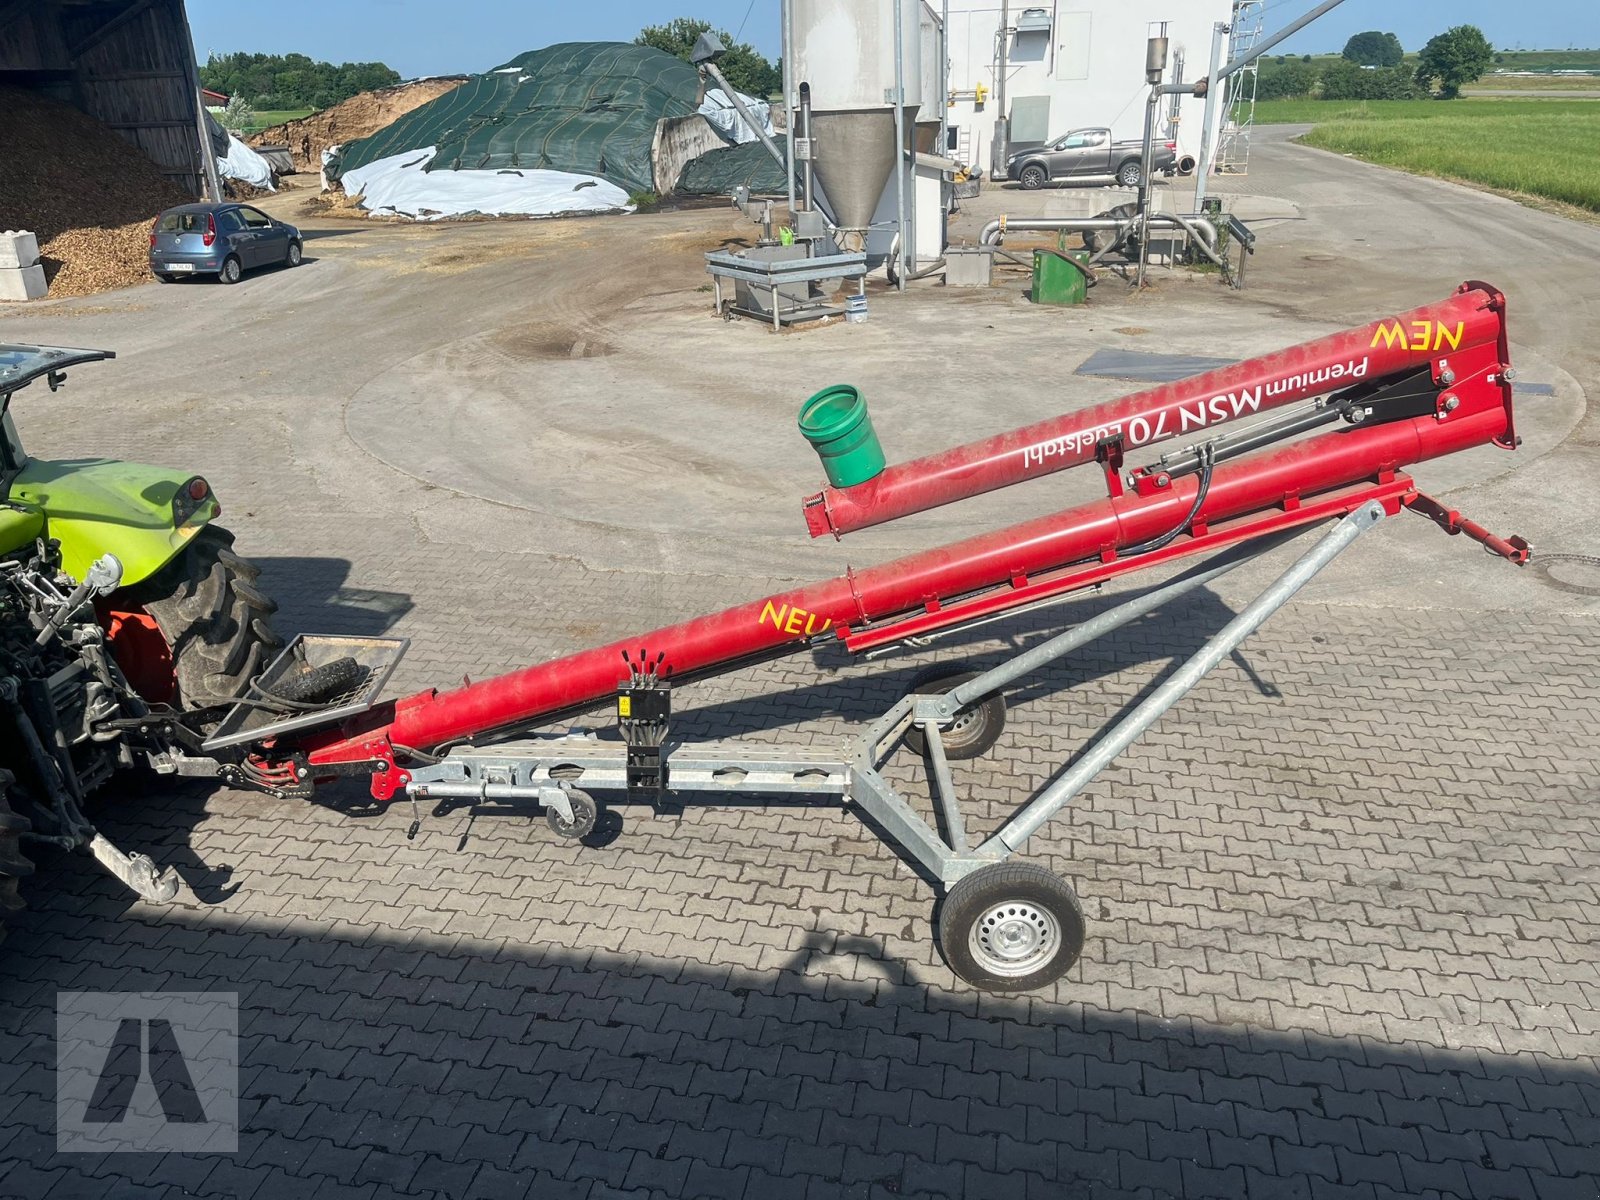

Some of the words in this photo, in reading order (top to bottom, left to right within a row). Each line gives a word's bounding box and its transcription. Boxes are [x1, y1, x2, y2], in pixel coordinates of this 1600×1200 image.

[1369, 320, 1465, 351] NEW
[1265, 356, 1369, 392] Premium
[1178, 385, 1262, 432] MSN
[1128, 411, 1173, 446] 70
[758, 599, 832, 636] NEU
